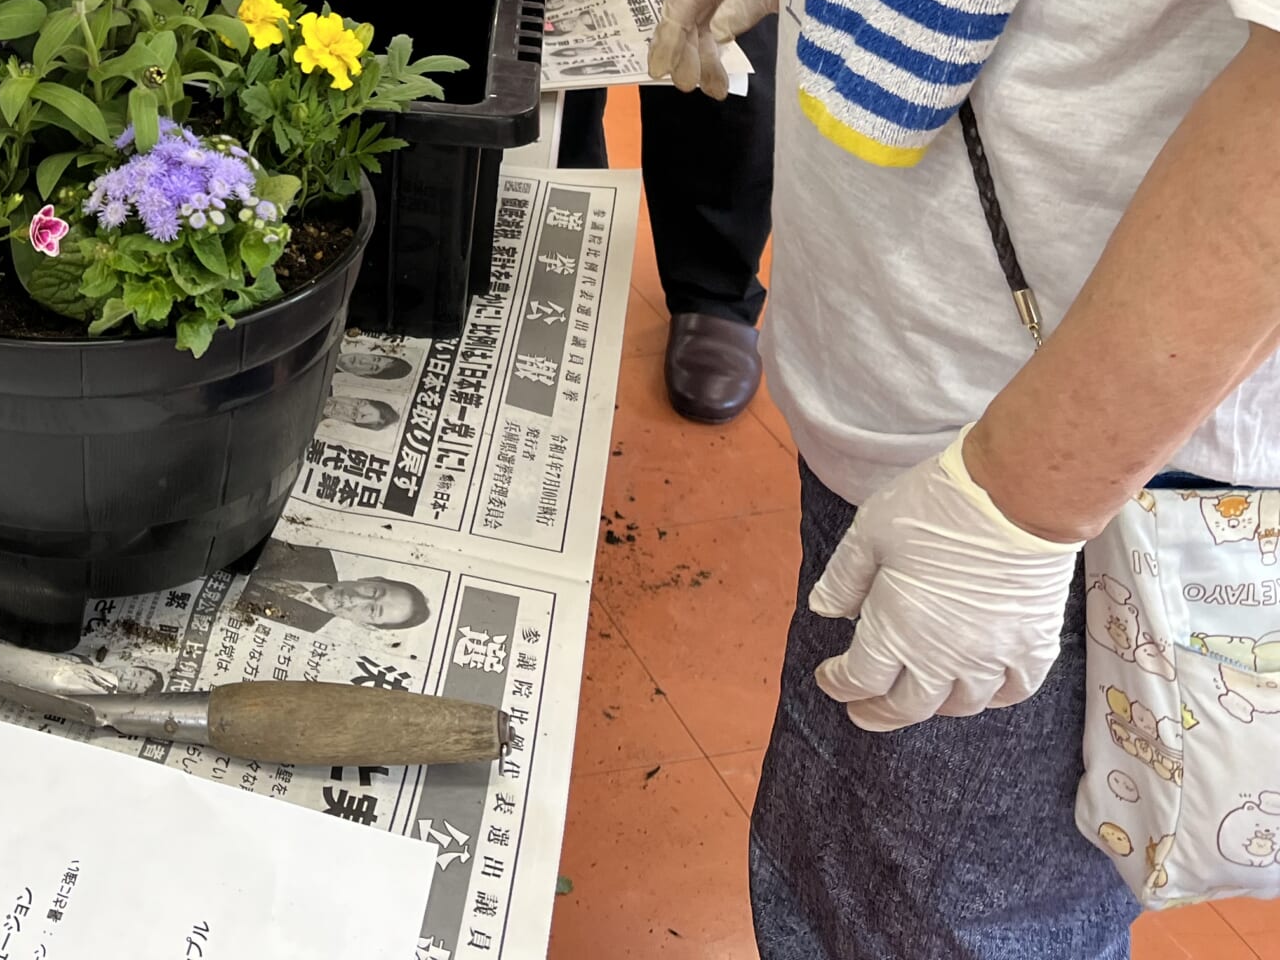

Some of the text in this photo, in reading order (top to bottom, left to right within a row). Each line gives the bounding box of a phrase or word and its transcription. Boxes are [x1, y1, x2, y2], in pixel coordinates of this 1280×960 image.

[511, 203, 583, 386] 選挙公報
[561, 207, 607, 403] 参議院比例代表選出議員選挙
[481, 419, 521, 531] 兵庫県選挙管理委員会
[521, 425, 539, 462] 発行者
[534, 431, 568, 528] 令和4年7月10日執行
[46, 857, 83, 925] 暑さに強い
[183, 915, 214, 960] プル
